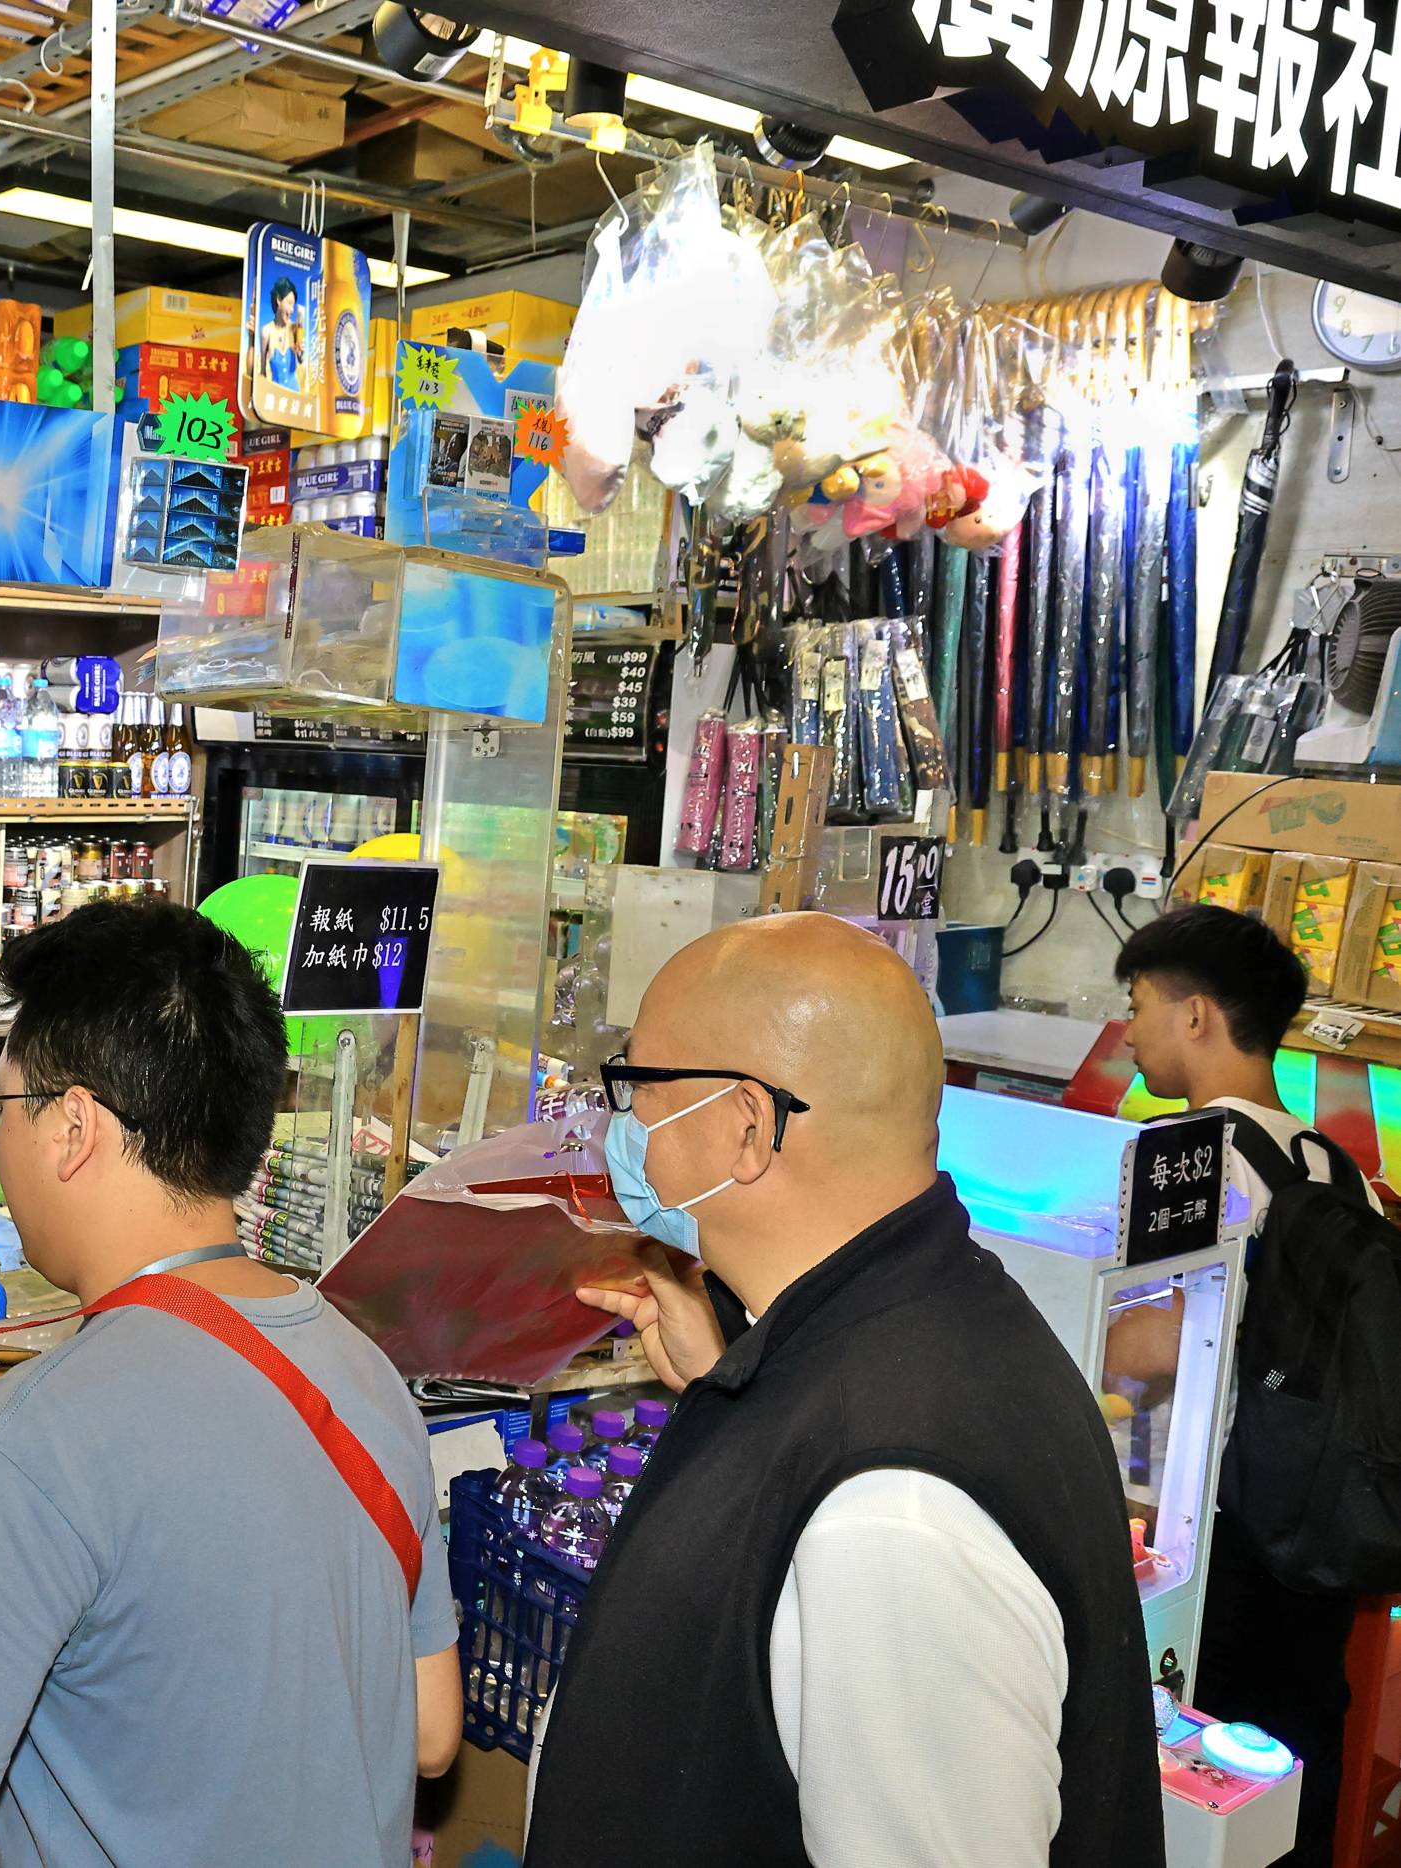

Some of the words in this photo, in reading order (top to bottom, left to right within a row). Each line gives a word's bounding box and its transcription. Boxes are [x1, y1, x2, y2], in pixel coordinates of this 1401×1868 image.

[271, 236, 293, 256] BLUE
[294, 244, 316, 262] GIRL
[419, 380, 440, 395] 103
[176, 411, 224, 449] 103
[528, 434, 548, 451] 116
[297, 474, 317, 487] BLUE
[318, 471, 340, 484] GIRL
[620, 666, 646, 679] $40
[618, 681, 643, 693] $45
[93, 685, 101, 707] BLUE
[612, 696, 637, 708] $39
[611, 711, 635, 723] $59
[309, 905, 355, 933] 報紙
[379, 905, 430, 933] $11.5
